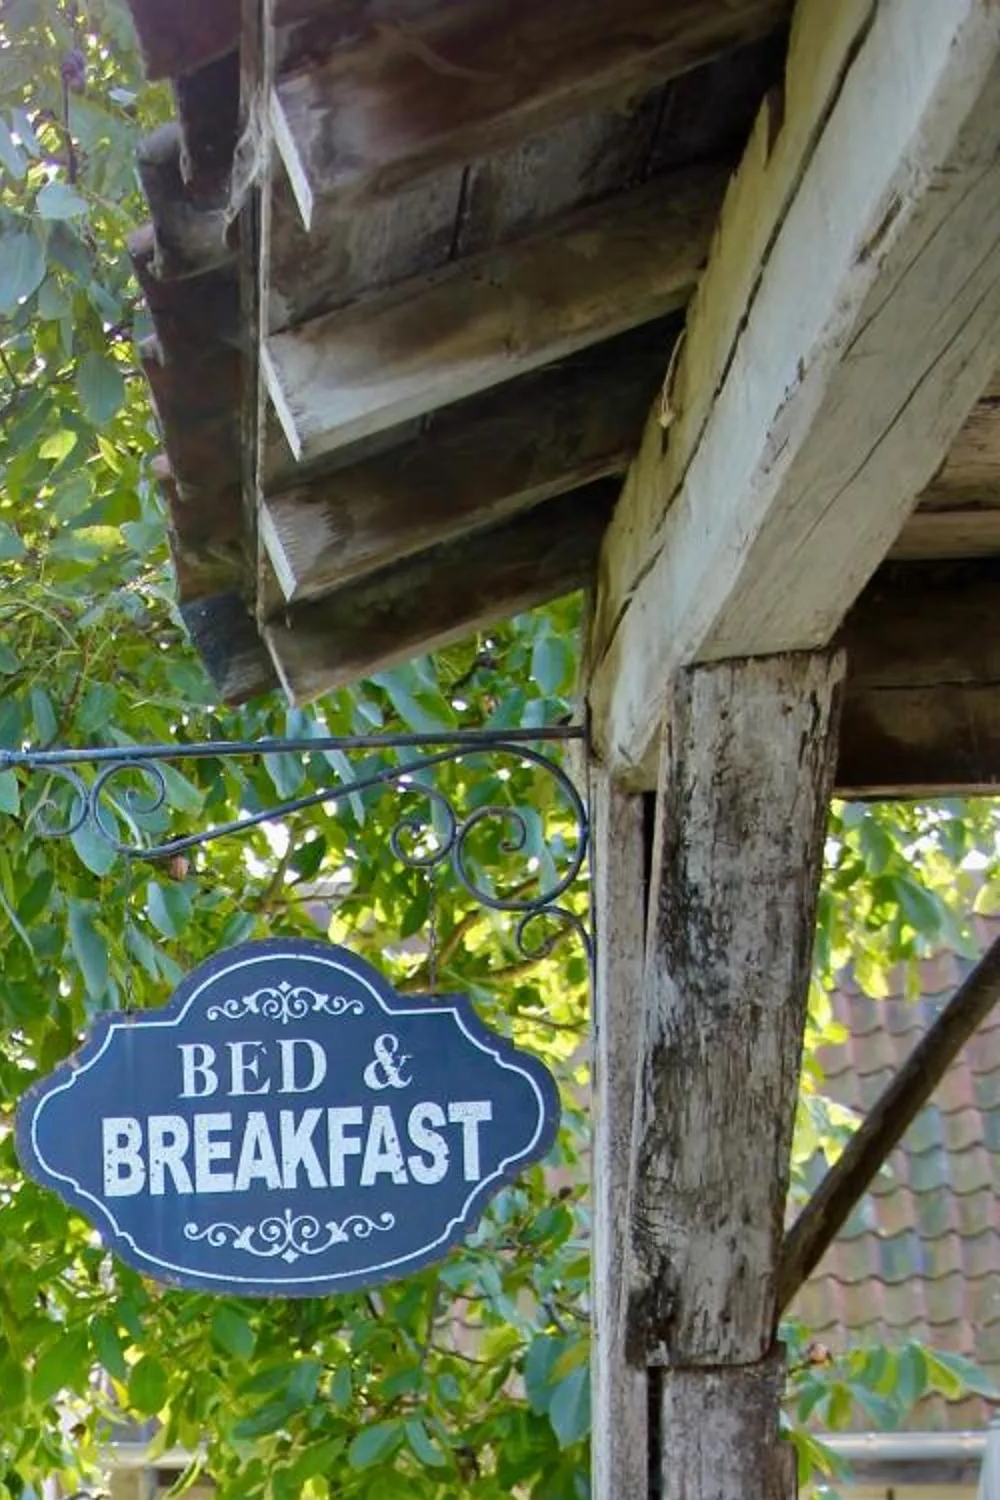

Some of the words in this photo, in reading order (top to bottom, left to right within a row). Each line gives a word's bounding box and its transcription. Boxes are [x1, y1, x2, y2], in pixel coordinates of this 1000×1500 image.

[177, 1038, 328, 1099] BED
[362, 1033, 414, 1091] &
[101, 1100, 493, 1198] BREAKFAST
